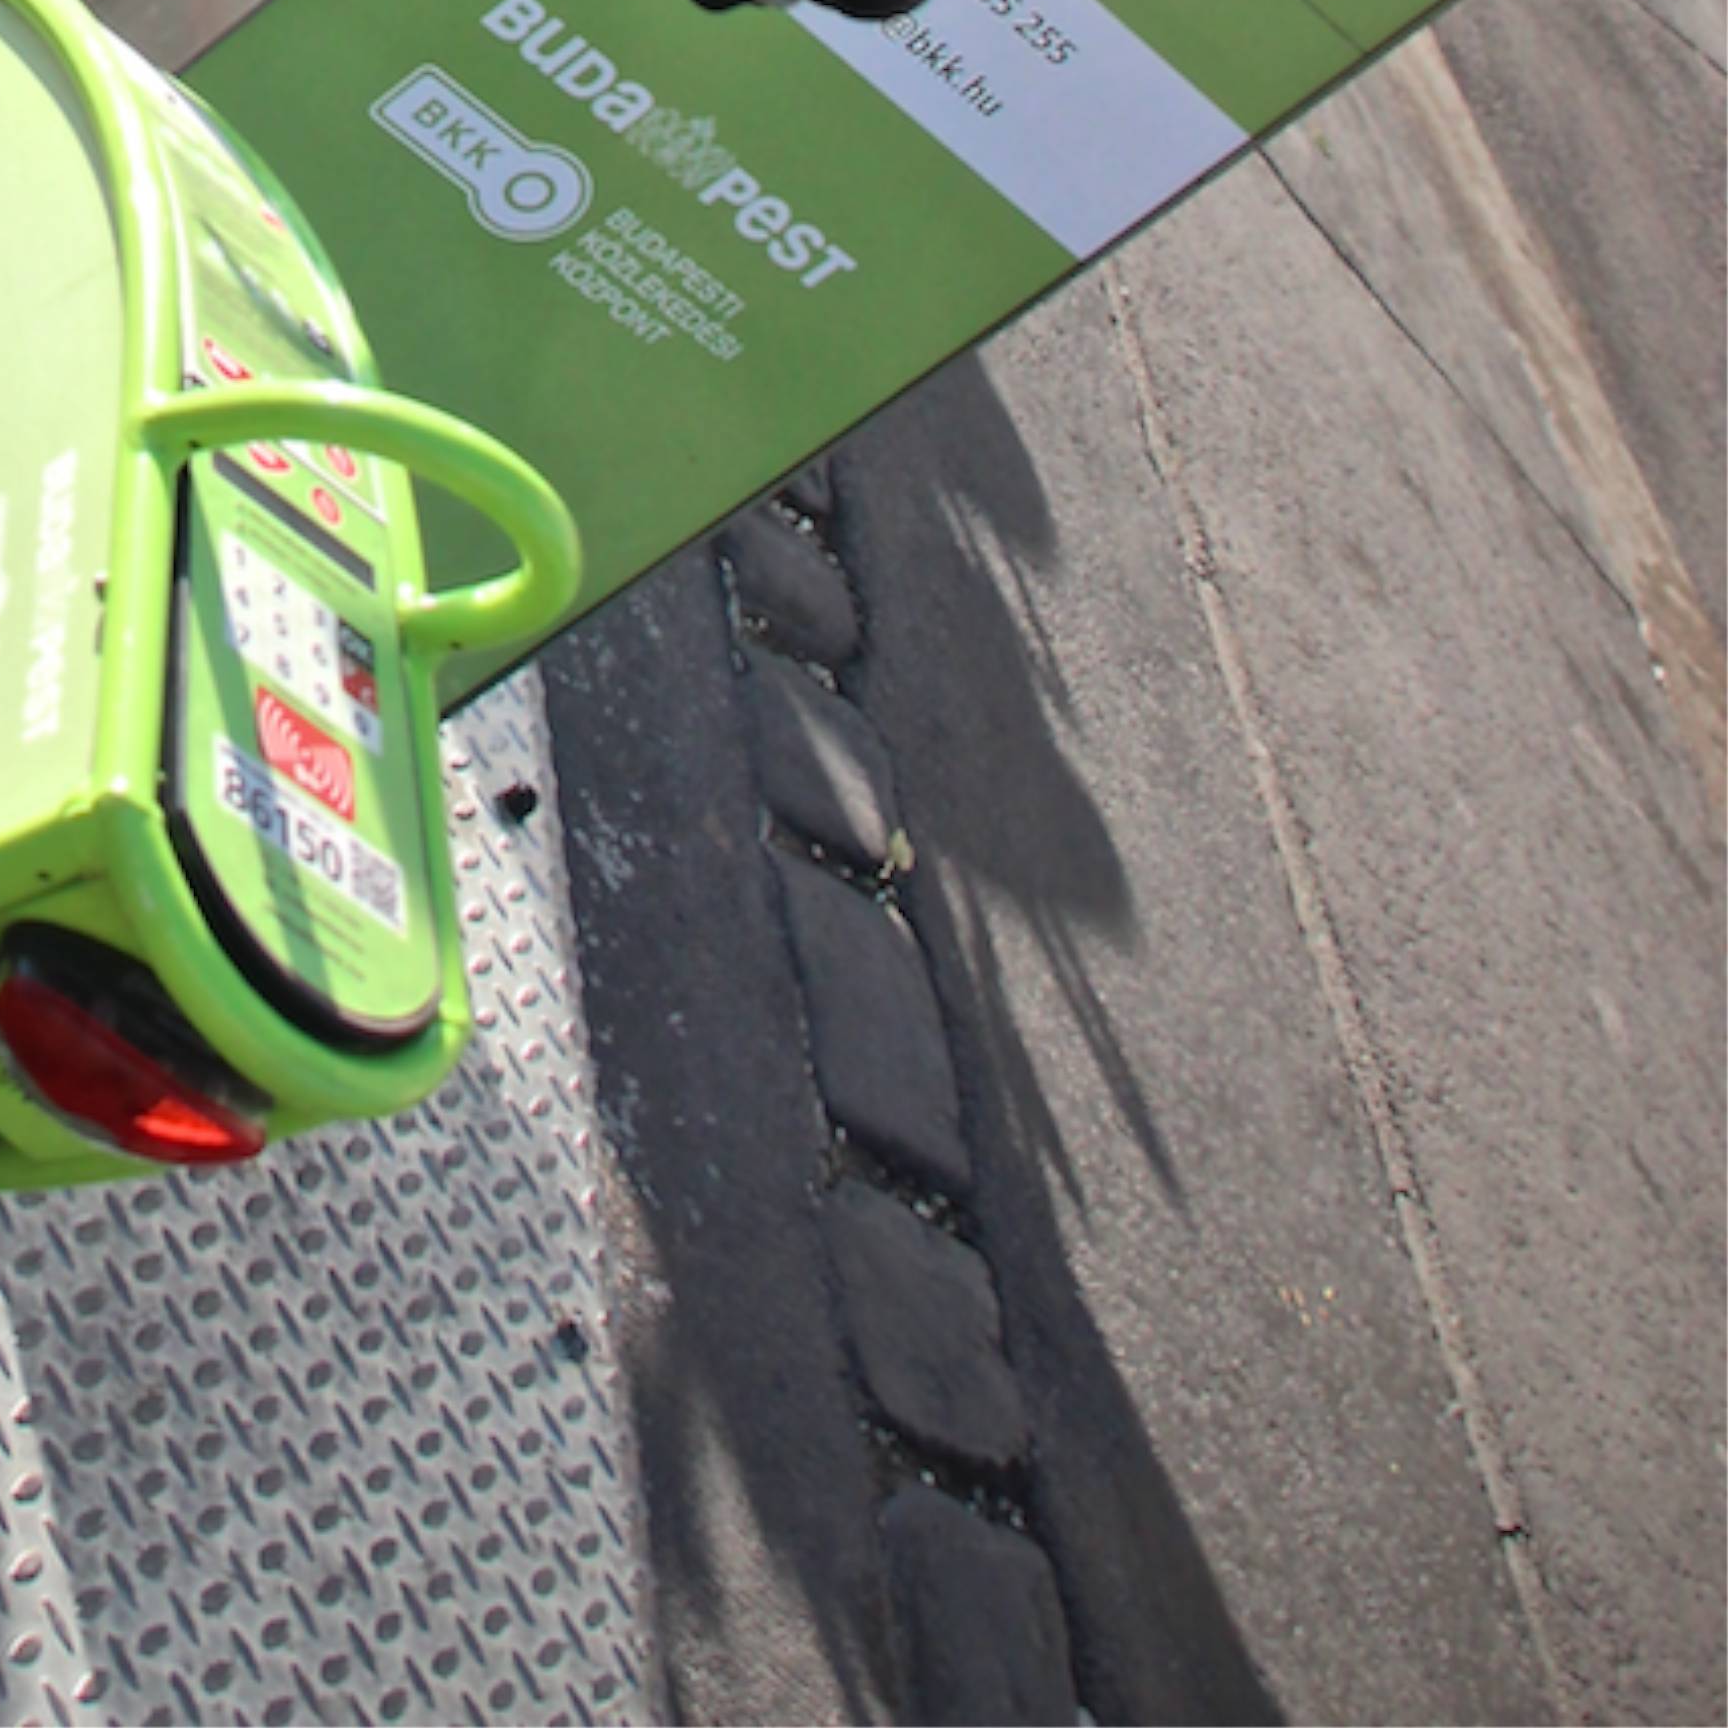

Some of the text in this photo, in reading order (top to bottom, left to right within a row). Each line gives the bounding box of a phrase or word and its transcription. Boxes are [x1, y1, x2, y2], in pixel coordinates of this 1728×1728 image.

[1013, 10, 1077, 65] 255
[411, 98, 502, 171] BKK
[549, 251, 672, 344] KÖZPONT
[576, 229, 745, 362] KÖZLEKEDÉSI
[606, 207, 746, 319] BUDAPESTI
[224, 765, 345, 883] 86150
